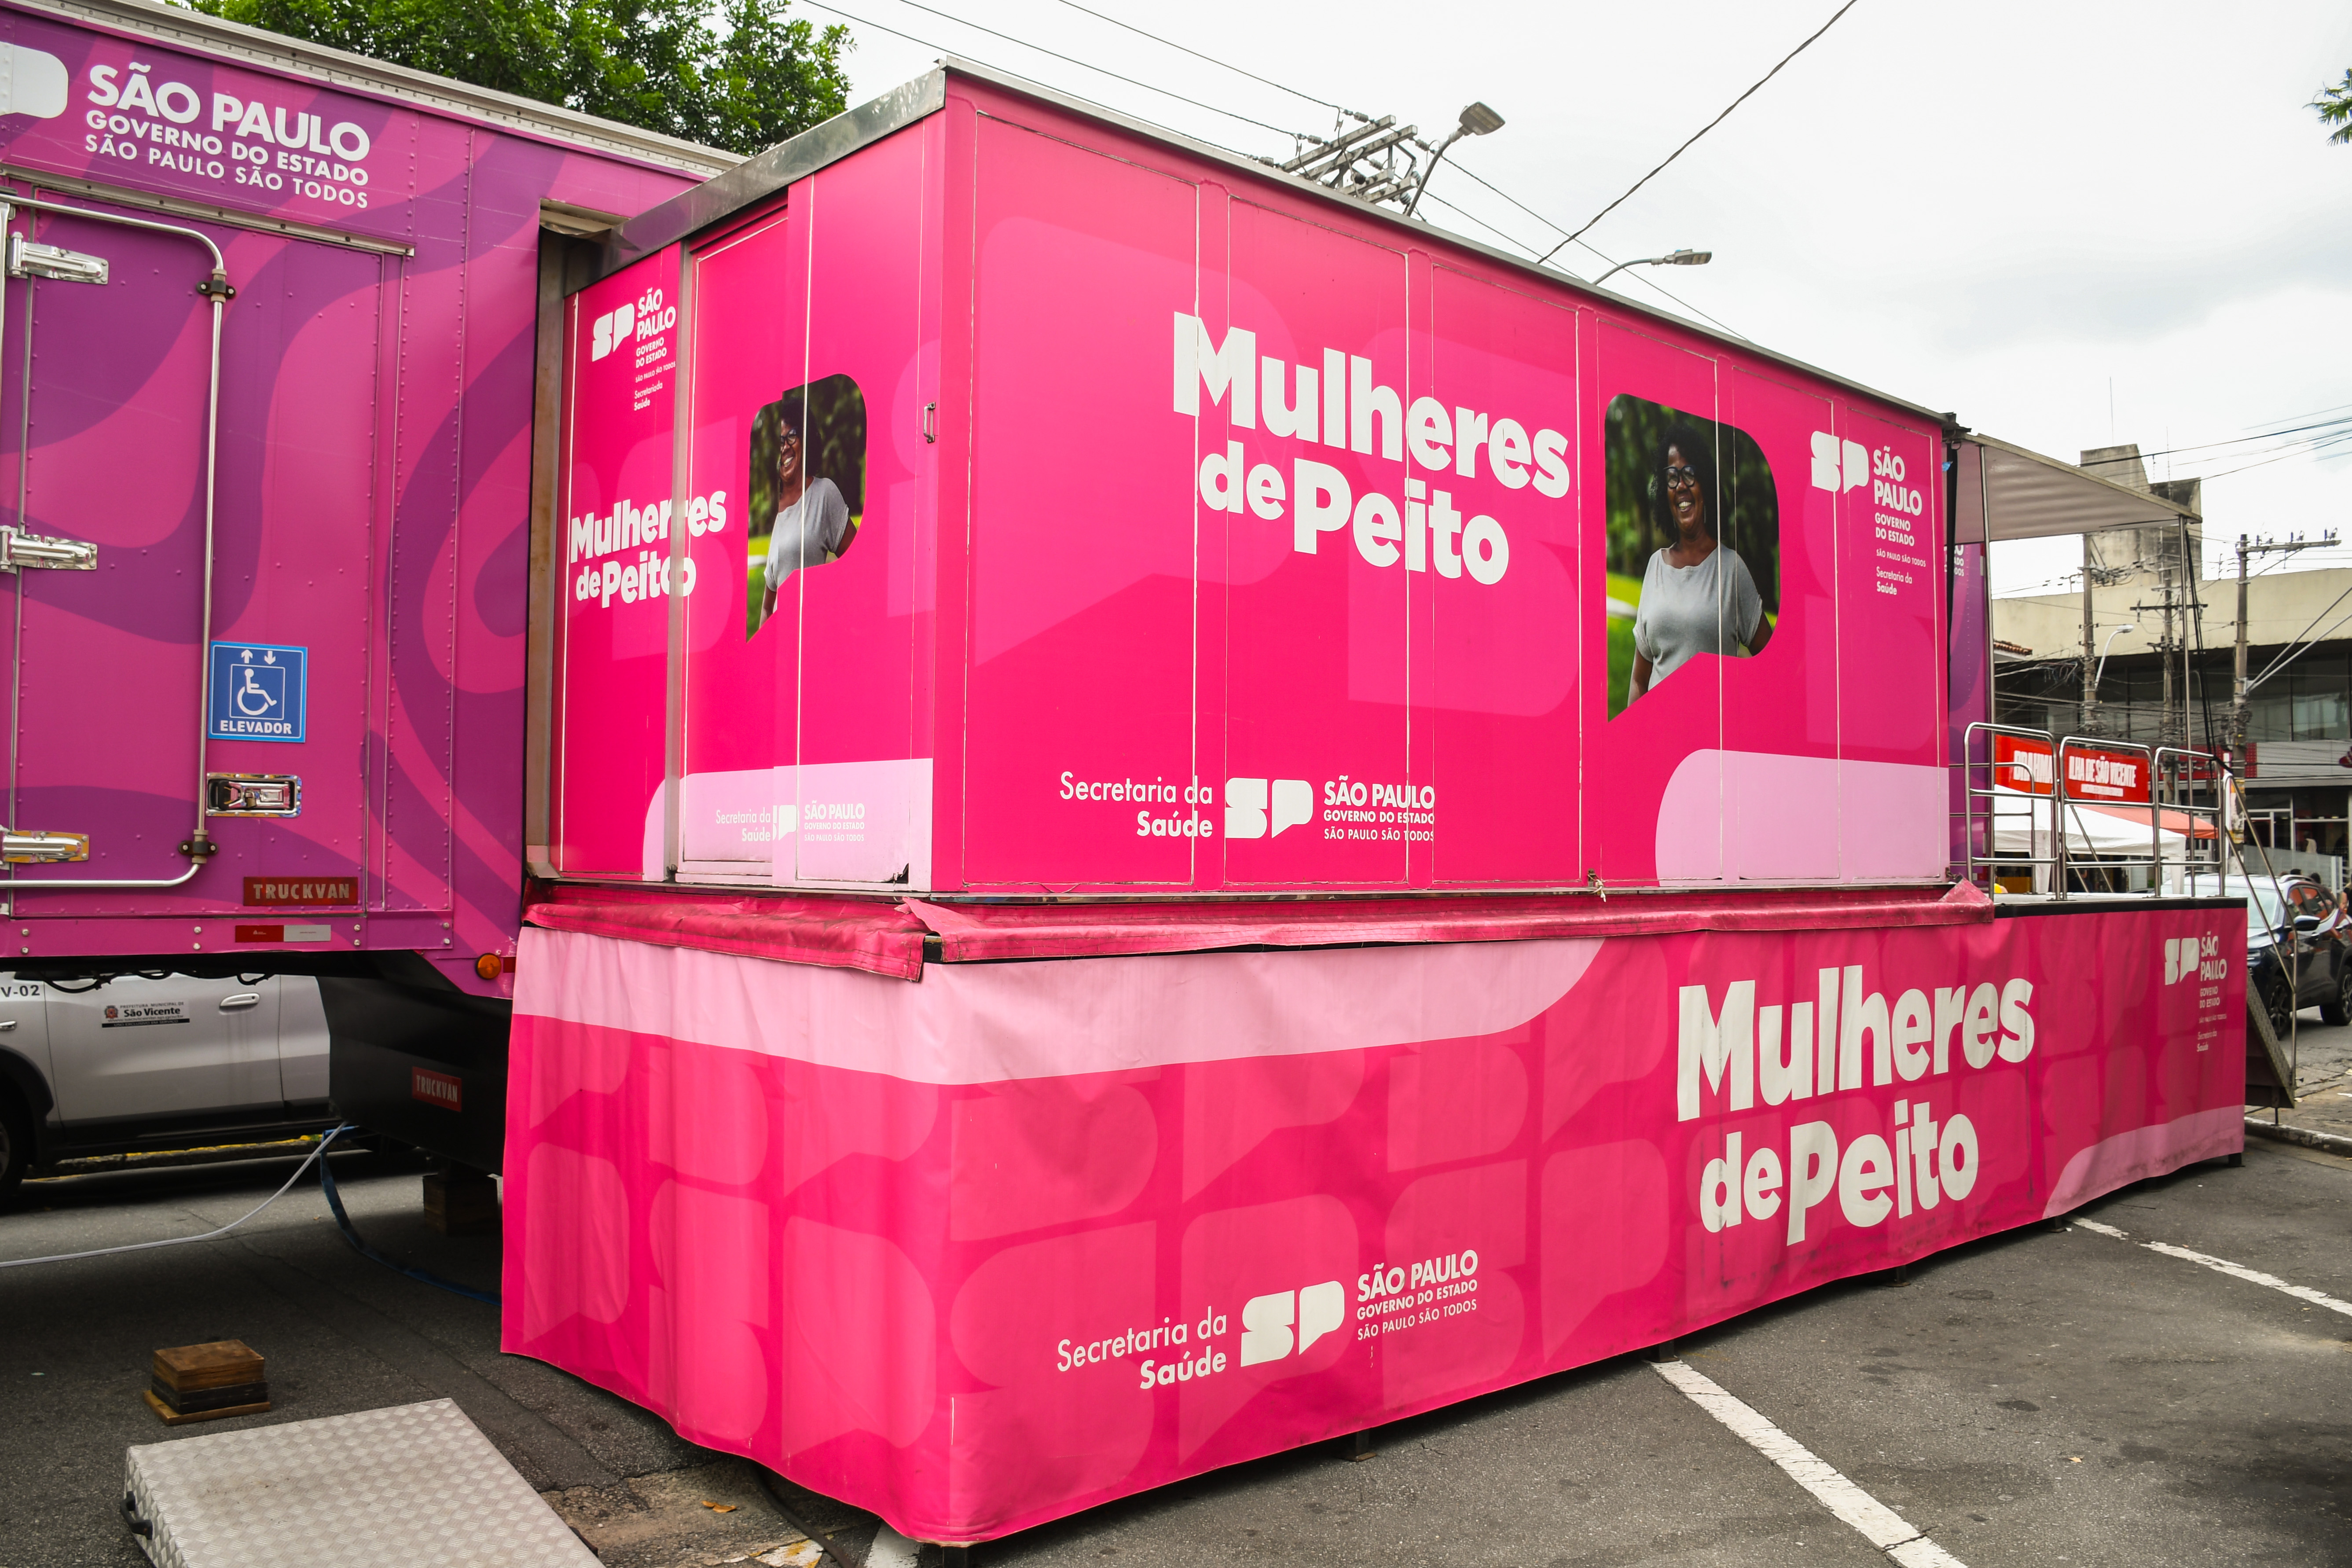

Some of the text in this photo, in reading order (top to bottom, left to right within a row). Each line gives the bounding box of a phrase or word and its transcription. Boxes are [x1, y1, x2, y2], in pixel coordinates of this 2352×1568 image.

[88, 62, 200, 124] SÃO
[212, 92, 370, 162] PAULO
[87, 110, 368, 186] GOVERNO DO ESTADO
[86, 134, 368, 209] SÃO PAULO SÃO TODOS
[638, 287, 663, 318] SÃO
[637, 306, 676, 342] PAULO
[636, 337, 664, 357] GOVERNO
[636, 347, 667, 368] DO ESTADO
[644, 370, 655, 379] PAULO
[663, 361, 675, 371] TODOS
[634, 397, 650, 411] Saúde
[1174, 311, 1570, 499] Mulheres
[1873, 445, 1905, 482] SÃO
[1874, 479, 1922, 516] PAULO
[1199, 440, 1509, 585] de Peito
[1875, 512, 1911, 532] GOVERNO
[571, 491, 727, 563] Mulheres
[1876, 527, 1915, 547] DO ESTADO
[1876, 548, 1926, 567] SÃO PAULO SÃO TODOS
[576, 550, 697, 608] de Peito
[1876, 566, 1912, 584] Secretaria da
[1877, 581, 1897, 595] Saúde
[220, 720, 292, 734] ELEVADOR
[1060, 771, 1213, 804] Secretaria da
[1324, 775, 1435, 809] SÃO PAULO
[716, 807, 771, 824] Secretaria da
[804, 800, 865, 820] SÃO PAULO
[1324, 809, 1435, 824] GOVERNO DO ESTADO
[742, 827, 771, 842] Saúde
[804, 822, 865, 830] GOVERNO DO ESTADO
[804, 833, 815, 841] SÃO
[834, 832, 845, 841] SÃO
[1137, 810, 1213, 837] Saúde
[1324, 826, 1434, 841] SÃO PAULO SÃO TODOS
[253, 884, 349, 899] TRUCKVAN
[2202, 931, 2219, 957] SÃO
[2200, 958, 2227, 982] PAULO
[0, 984, 40, 998] V-02
[144, 1007, 180, 1016] Vicente
[1677, 965, 2035, 1122] Mulheres
[417, 1075, 457, 1102] TRUCKVAN
[1700, 1098, 1978, 1247] de Peito
[1357, 1249, 1478, 1302] SÃO PAULO
[1357, 1279, 1478, 1320] GOVERNO DO ESTADO
[1358, 1299, 1477, 1340] SÃO PAULO SÃO TODOS
[1057, 1306, 1227, 1372] Secretaria da
[1139, 1346, 1227, 1389] Saúde
